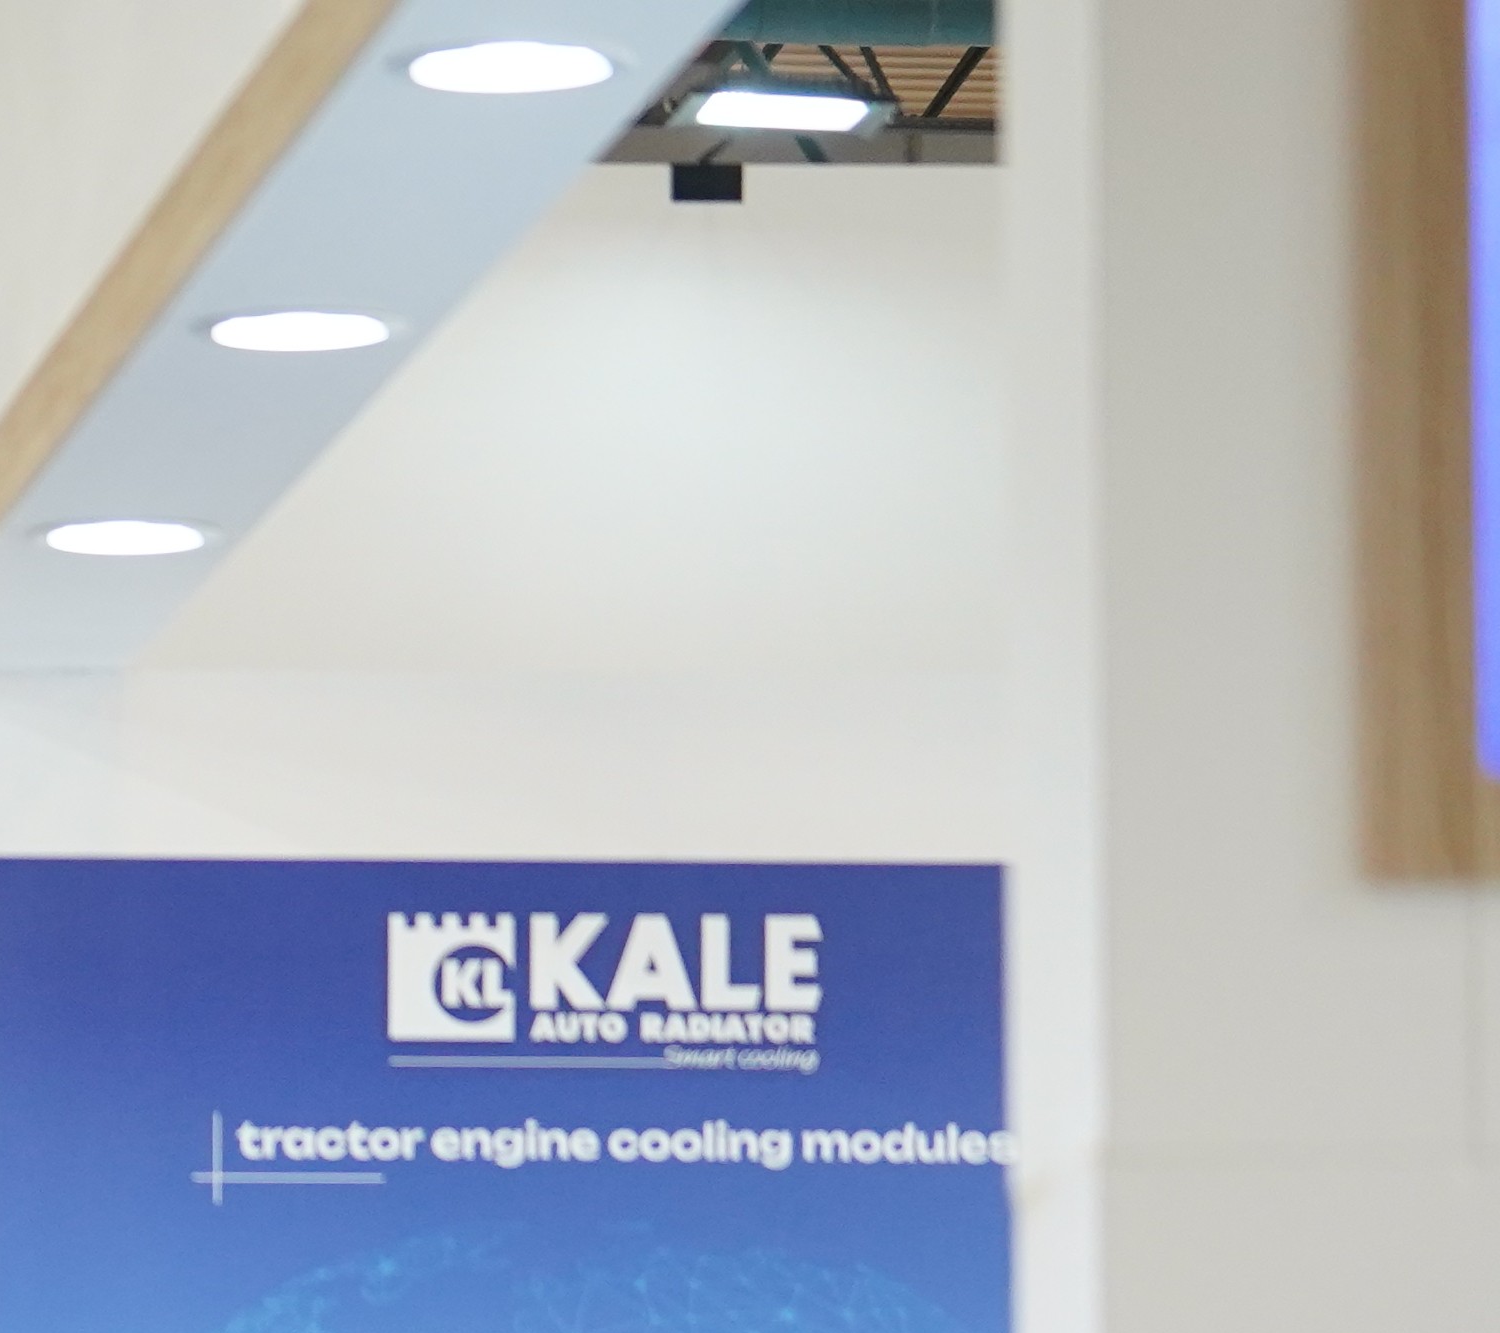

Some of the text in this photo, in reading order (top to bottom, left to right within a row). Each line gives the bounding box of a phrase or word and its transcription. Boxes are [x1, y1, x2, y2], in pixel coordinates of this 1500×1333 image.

[440, 958, 514, 1010] KL
[529, 911, 823, 1013] KALE
[529, 1012, 816, 1044] AUTO RADIATOR
[236, 1120, 426, 1161] tractor
[430, 1117, 600, 1169] engine
[607, 1118, 793, 1171] cooling
